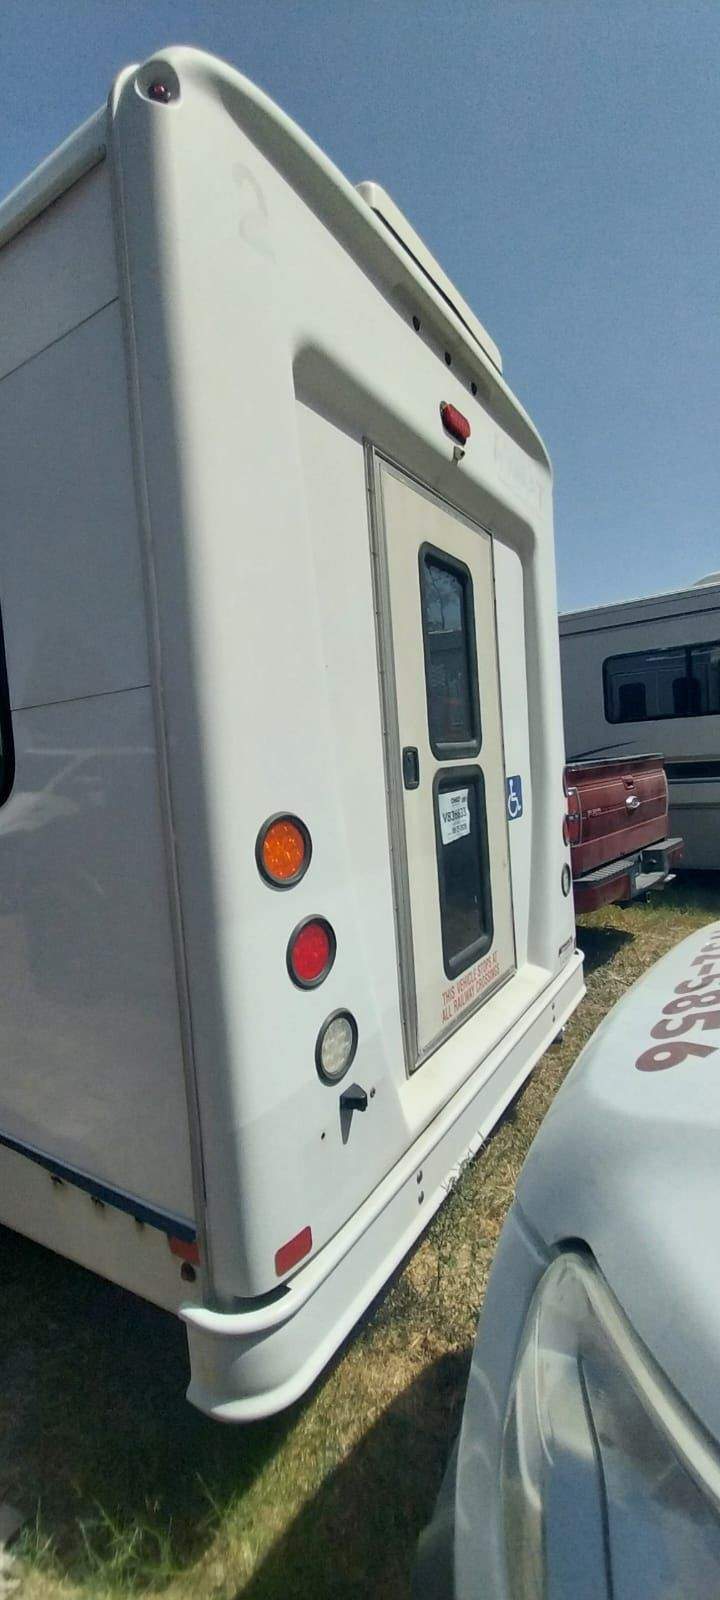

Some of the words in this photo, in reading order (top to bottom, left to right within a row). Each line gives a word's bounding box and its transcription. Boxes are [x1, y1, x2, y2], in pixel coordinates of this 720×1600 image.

[442, 985, 456, 1006] THIS
[456, 968, 478, 994] VEHICLE
[477, 955, 493, 979] STOPS
[442, 1005, 453, 1024] ALL
[453, 983, 475, 1011] RAILWAY
[475, 963, 500, 992] CROSSINGS
